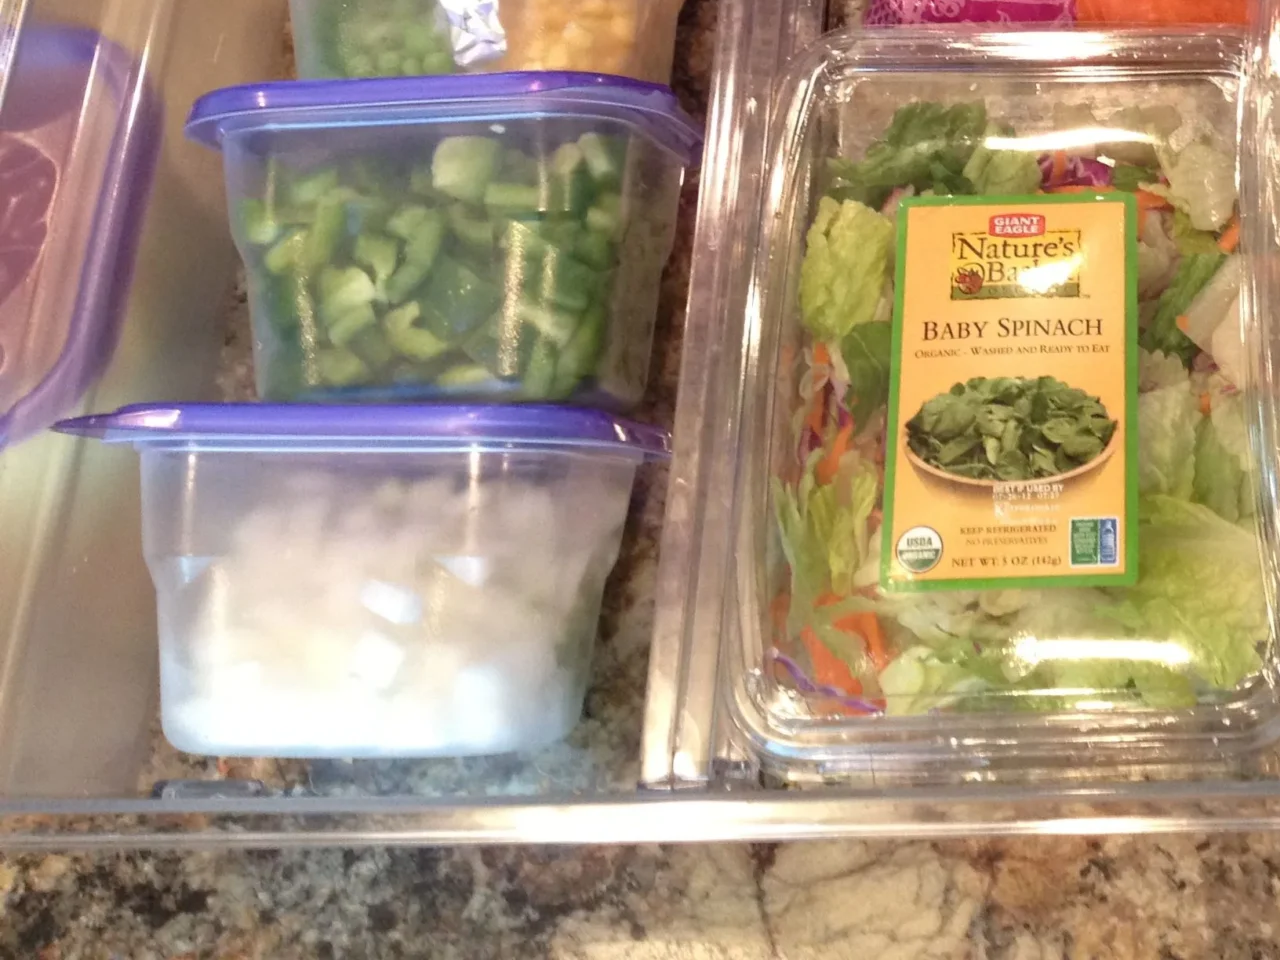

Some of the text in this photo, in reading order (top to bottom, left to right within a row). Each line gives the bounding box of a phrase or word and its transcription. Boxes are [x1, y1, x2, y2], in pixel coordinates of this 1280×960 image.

[994, 216, 1040, 226] GIANT
[994, 225, 1039, 234] EAGLE
[957, 237, 1075, 260] Nature's
[922, 318, 1104, 341] BABY SPINACH
[914, 343, 1111, 359] ORGANIC WASHED AND READY TO EAT
[960, 524, 1057, 536] KEEP REFRIGERATED
[905, 537, 933, 549] USDA
[964, 538, 981, 546] NO
[952, 557, 976, 568] NET
[1010, 557, 1029, 566] OZ
